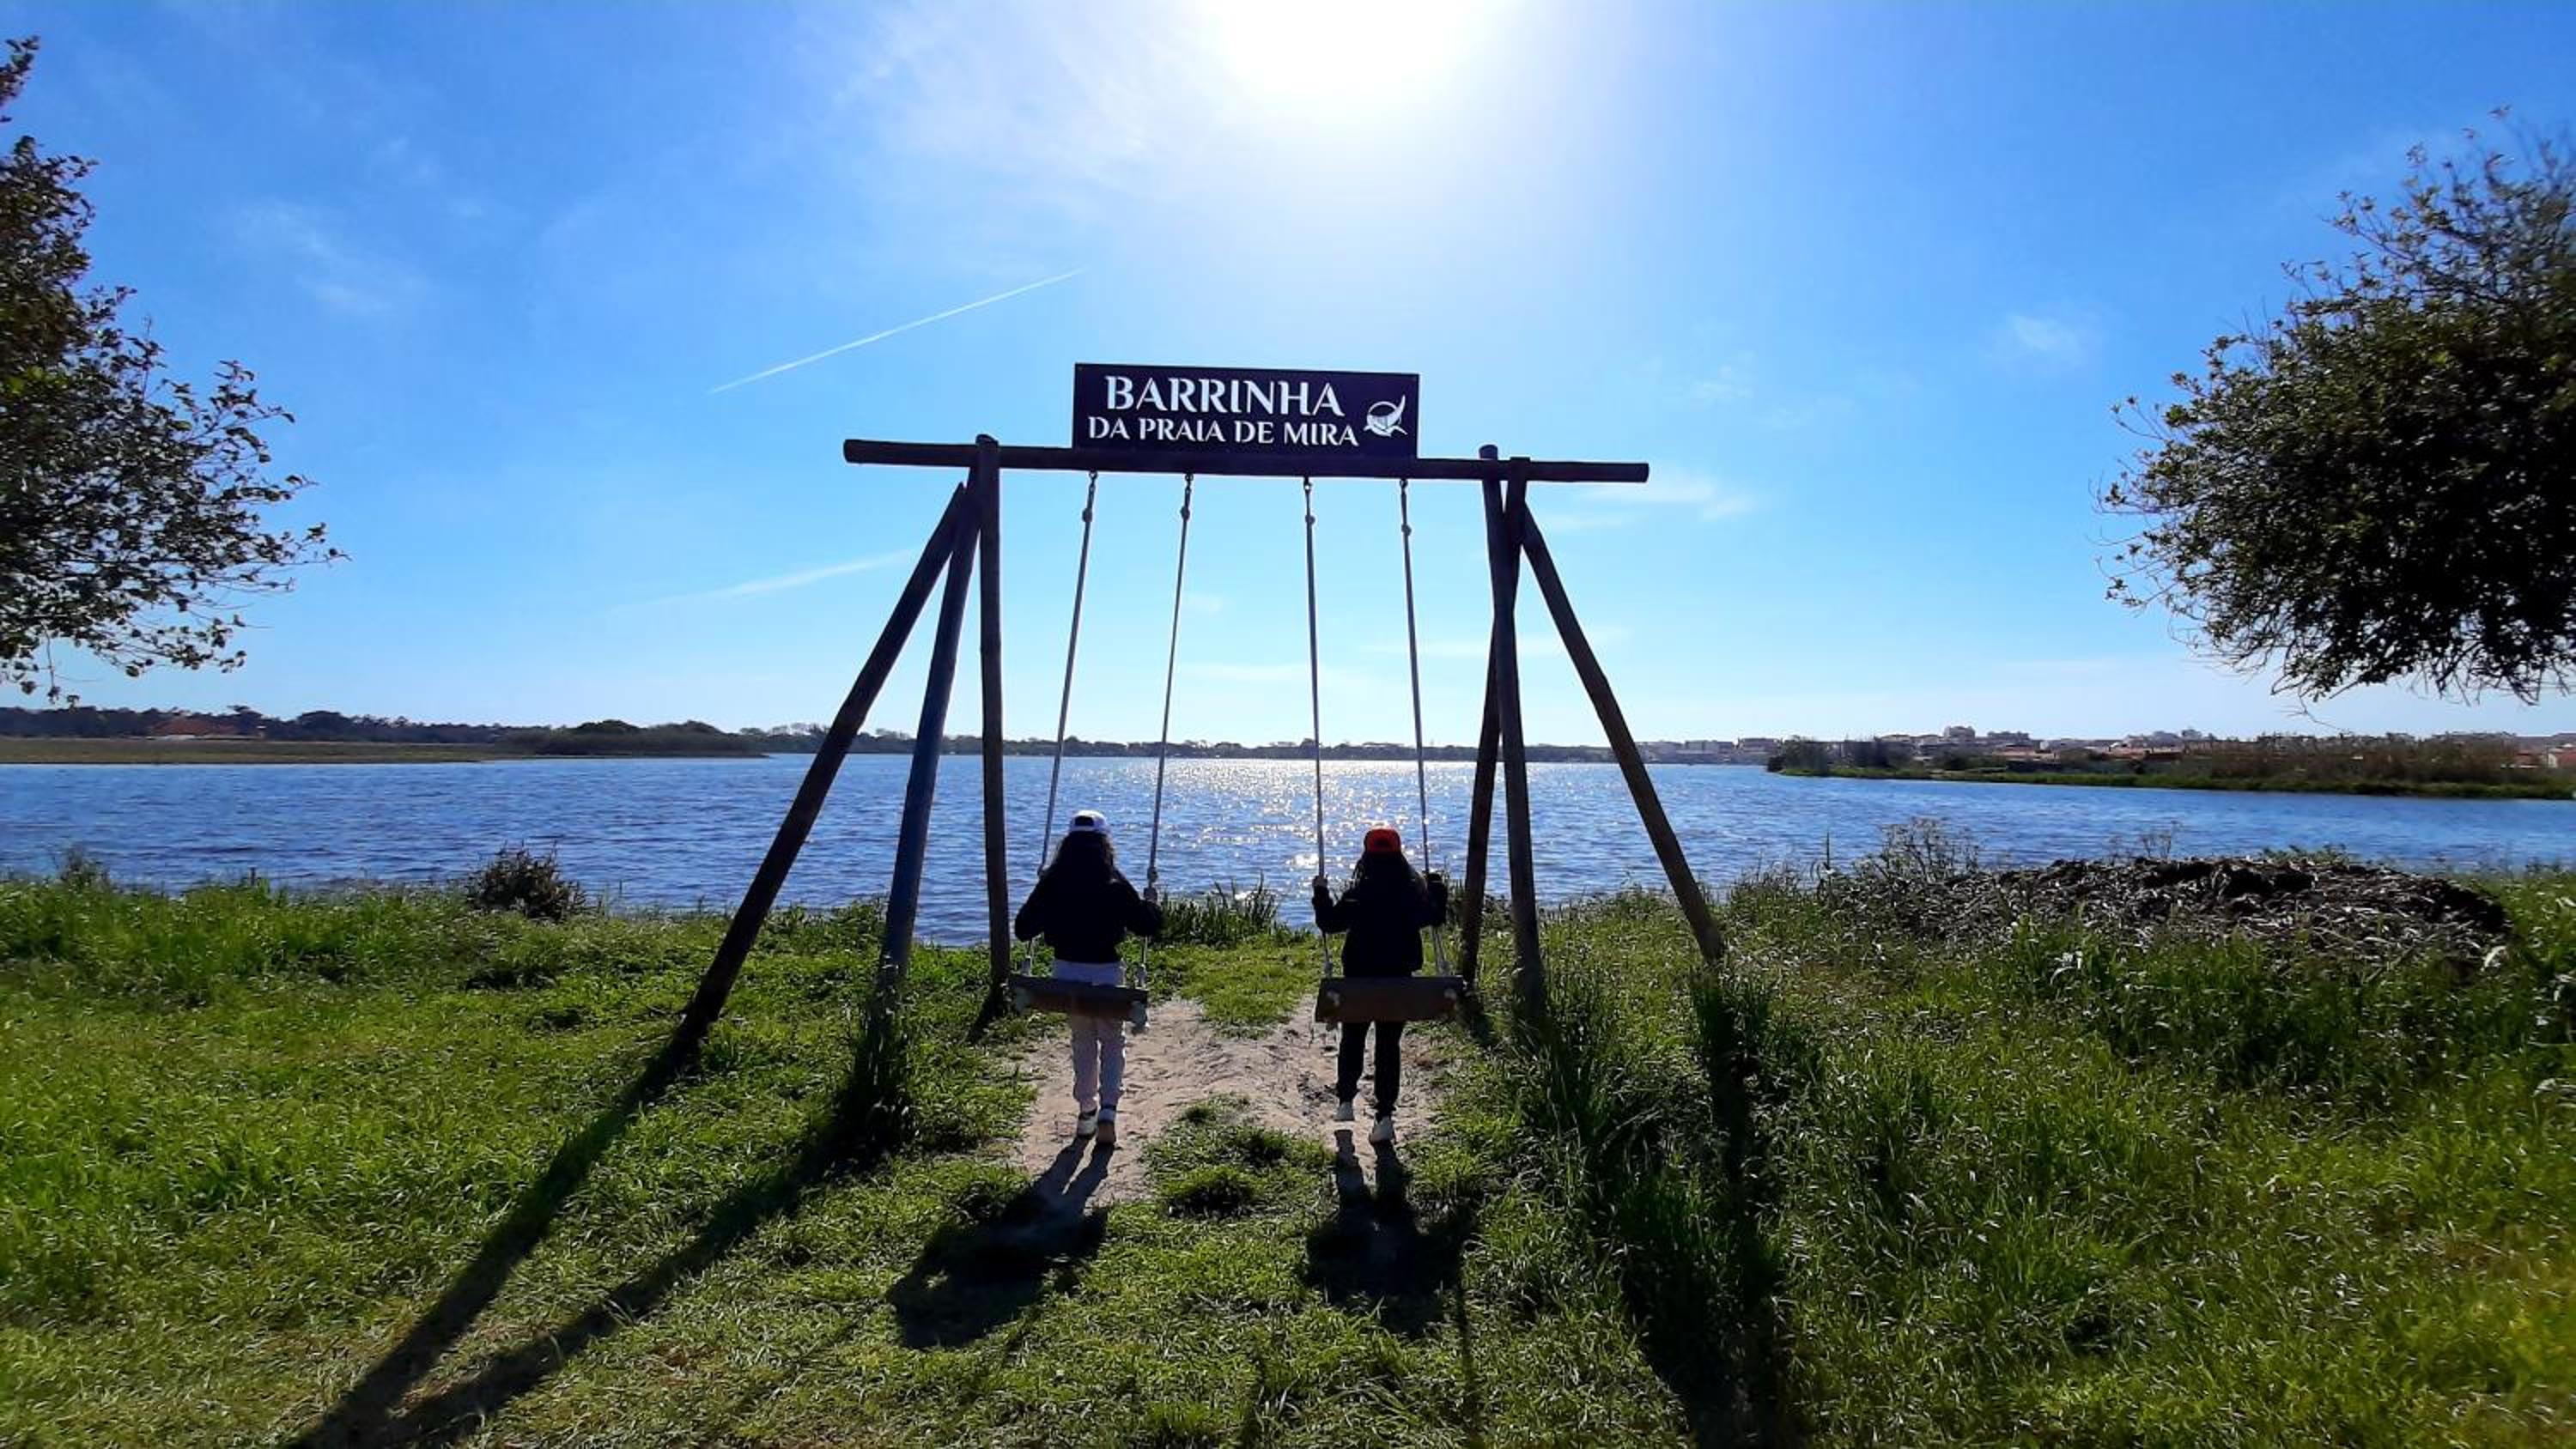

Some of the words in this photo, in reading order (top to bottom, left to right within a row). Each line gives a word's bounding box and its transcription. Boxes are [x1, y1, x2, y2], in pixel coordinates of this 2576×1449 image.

[1105, 376, 1346, 417] BARRINHA
[1088, 416, 1130, 440] DA
[1139, 418, 1226, 443] PRAIA
[1234, 421, 1274, 445] DE
[1284, 421, 1359, 447] MIRA
